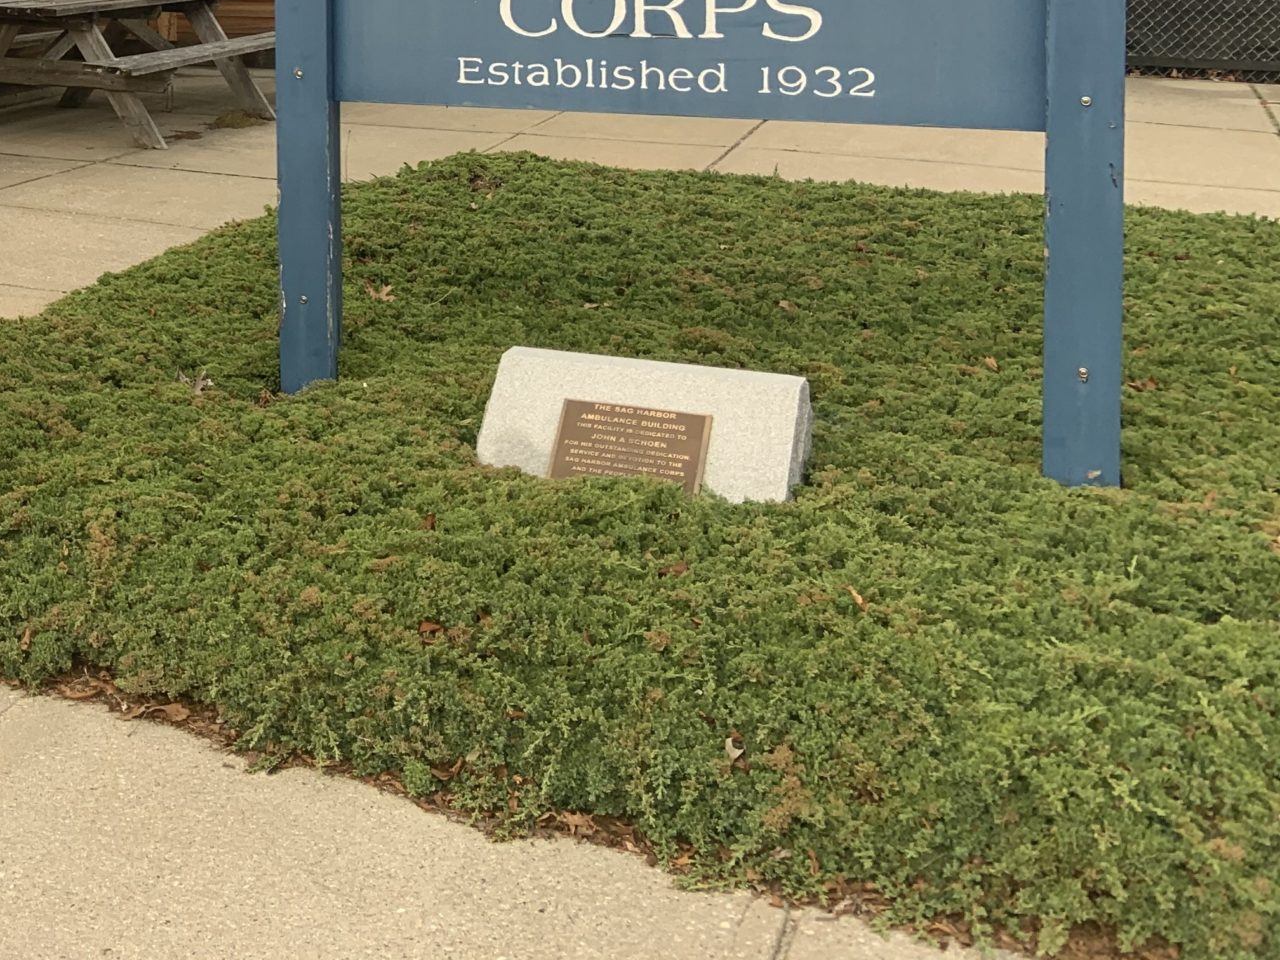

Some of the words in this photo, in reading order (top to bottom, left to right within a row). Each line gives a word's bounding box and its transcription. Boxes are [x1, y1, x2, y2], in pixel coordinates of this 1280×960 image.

[456, 56, 729, 94] Established
[757, 65, 876, 98] 1932
[594, 403, 612, 413] THE
[614, 406, 634, 415] SAG
[636, 408, 678, 420] HARBOR
[580, 414, 637, 425] AMBULANCE
[640, 420, 686, 431] BUILDING
[634, 430, 675, 439] DEDICATED
[628, 438, 667, 448] SCHOEN
[569, 448, 599, 456] SERVICE
[595, 444, 644, 454] OUTSTANDING
[646, 450, 690, 460] DEDICATION
[580, 458, 610, 466] HARBOR
[612, 462, 657, 473] AMBULANCE
[659, 468, 685, 477] CORPS
